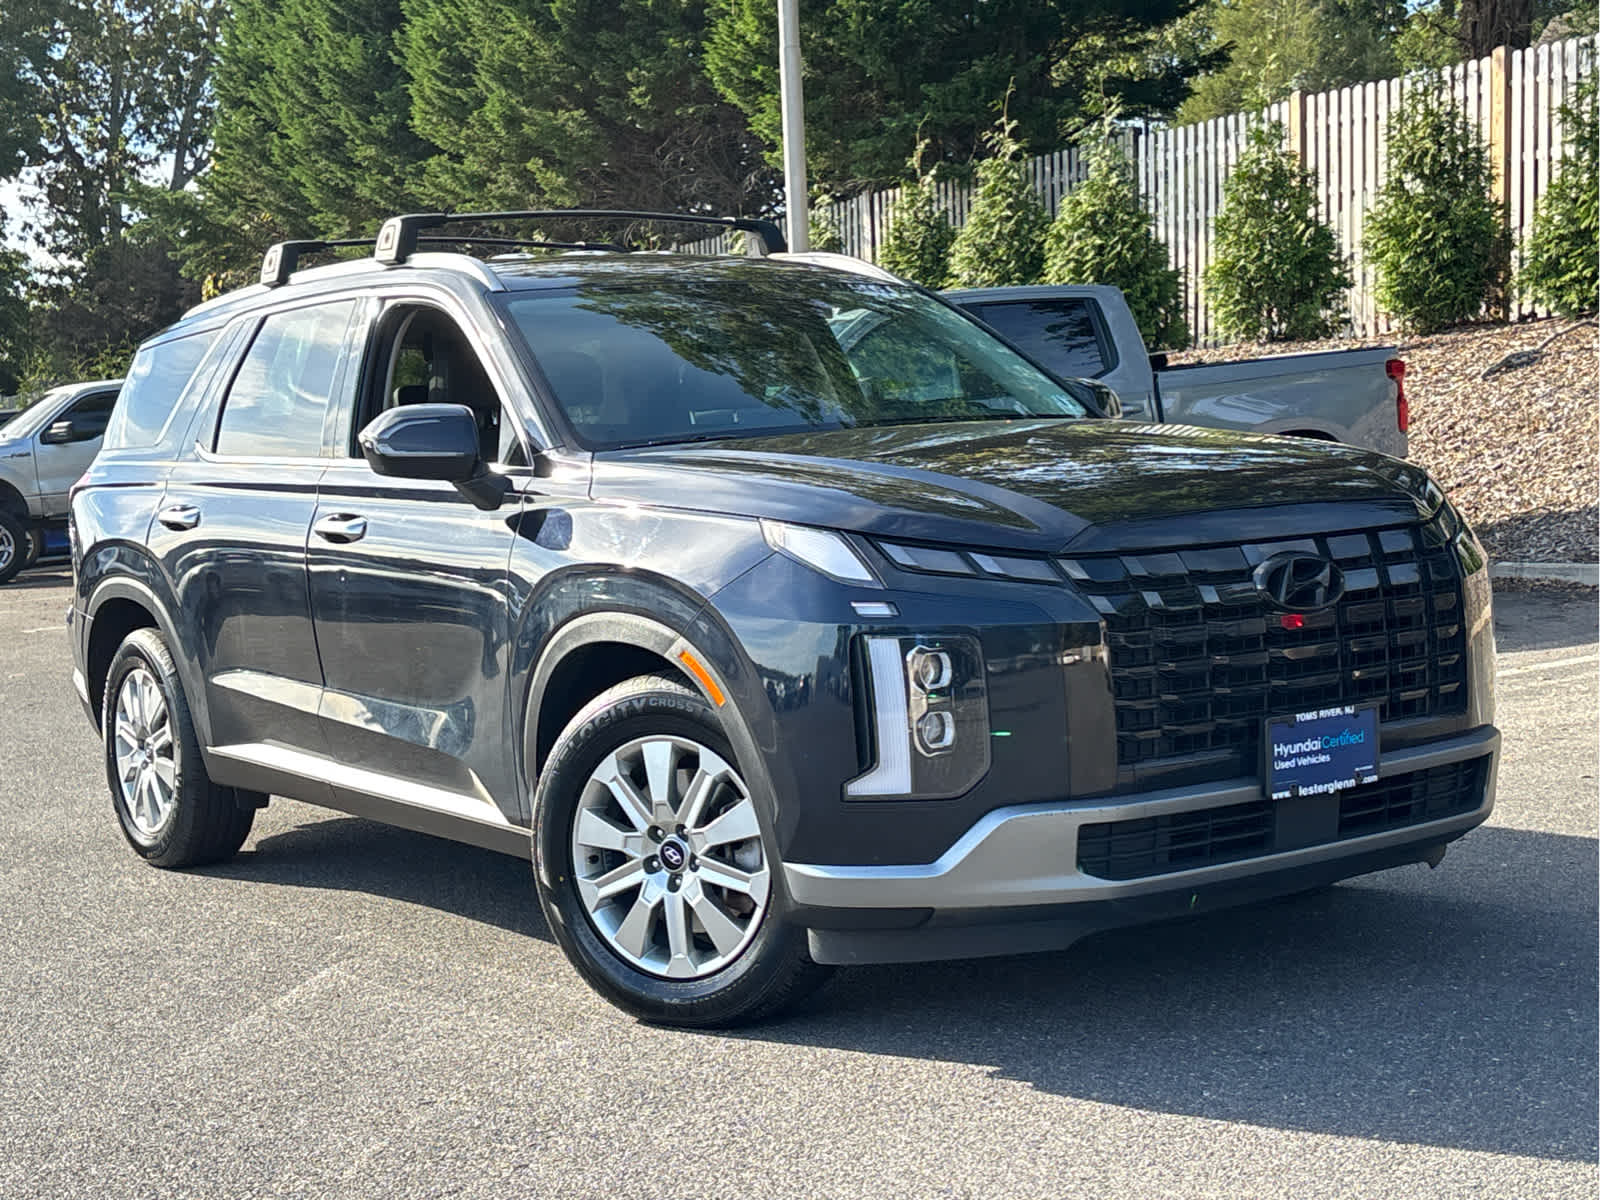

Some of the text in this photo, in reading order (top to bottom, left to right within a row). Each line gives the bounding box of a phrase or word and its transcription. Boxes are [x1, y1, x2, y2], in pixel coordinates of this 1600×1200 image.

[648, 697, 694, 713] CROSS
[1295, 710, 1318, 723] TOMS
[1344, 704, 1355, 714] NJ
[1274, 753, 1331, 770] Used Vehicles
